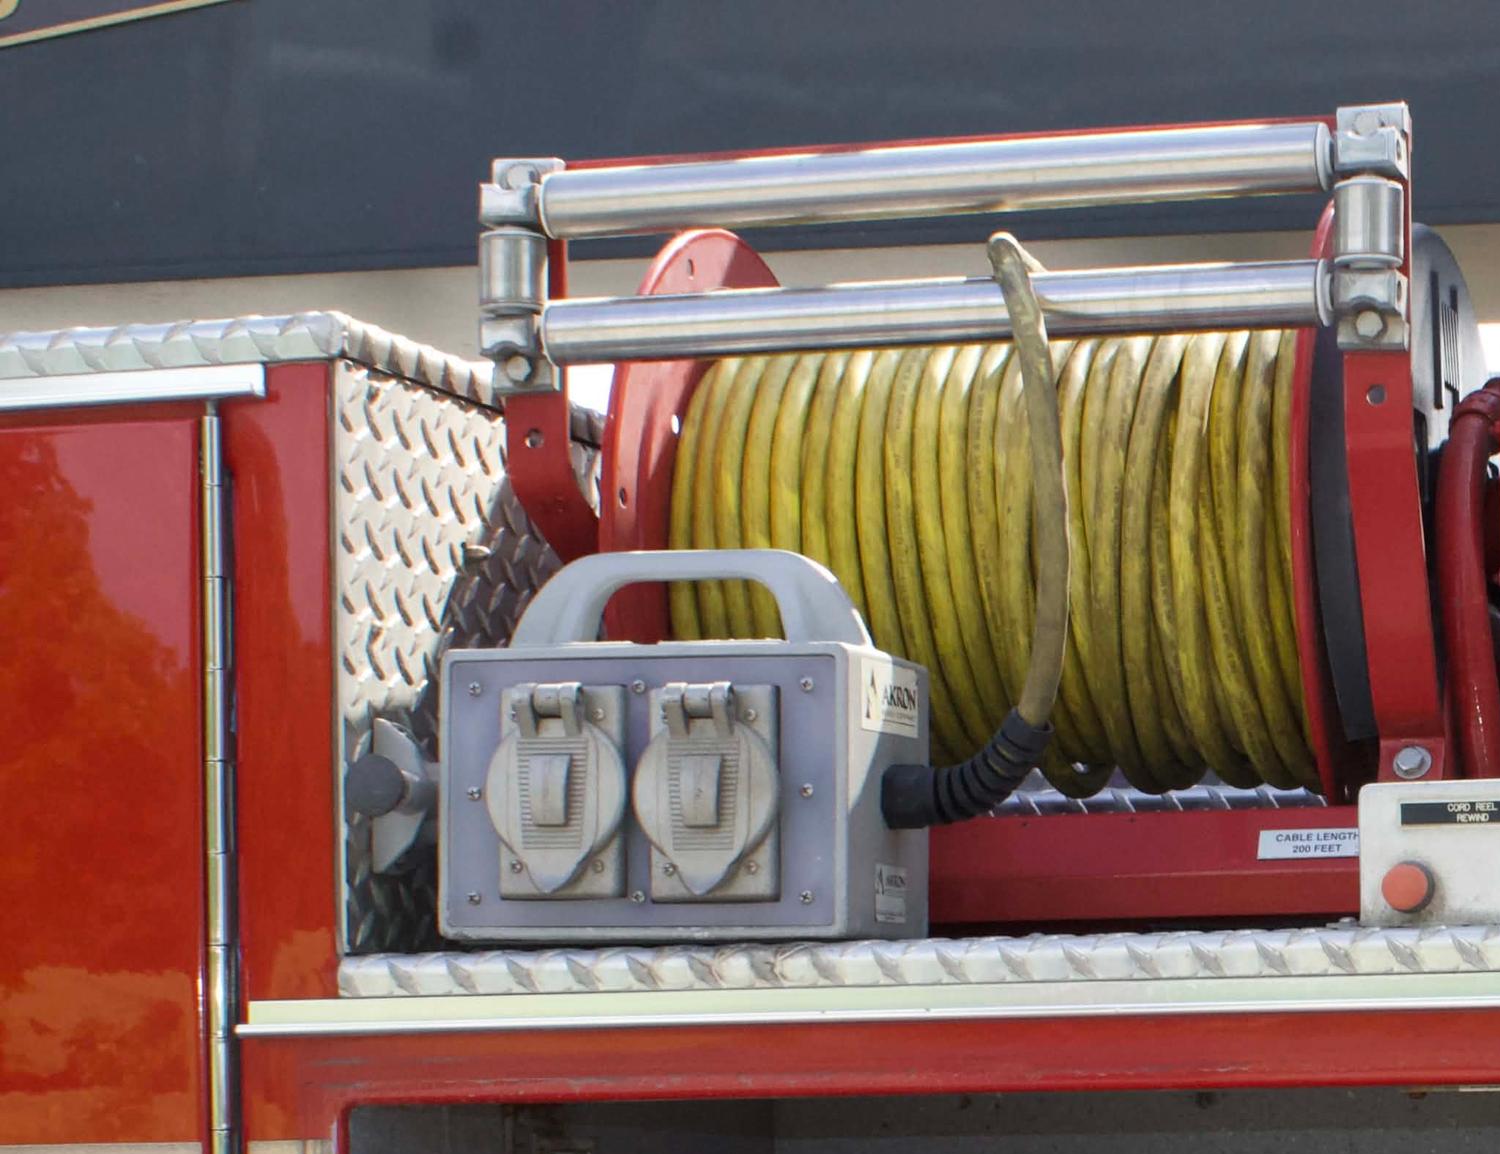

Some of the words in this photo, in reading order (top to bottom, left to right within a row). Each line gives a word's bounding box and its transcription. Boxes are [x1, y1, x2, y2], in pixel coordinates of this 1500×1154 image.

[883, 684, 917, 710] AKRON
[1447, 802, 1471, 812] CORD
[1475, 802, 1498, 812] REEL
[1456, 813, 1490, 823] REWIND
[1275, 832, 1314, 842] CABLE
[1292, 845, 1312, 853] 200
[1313, 844, 1343, 853] FEET
